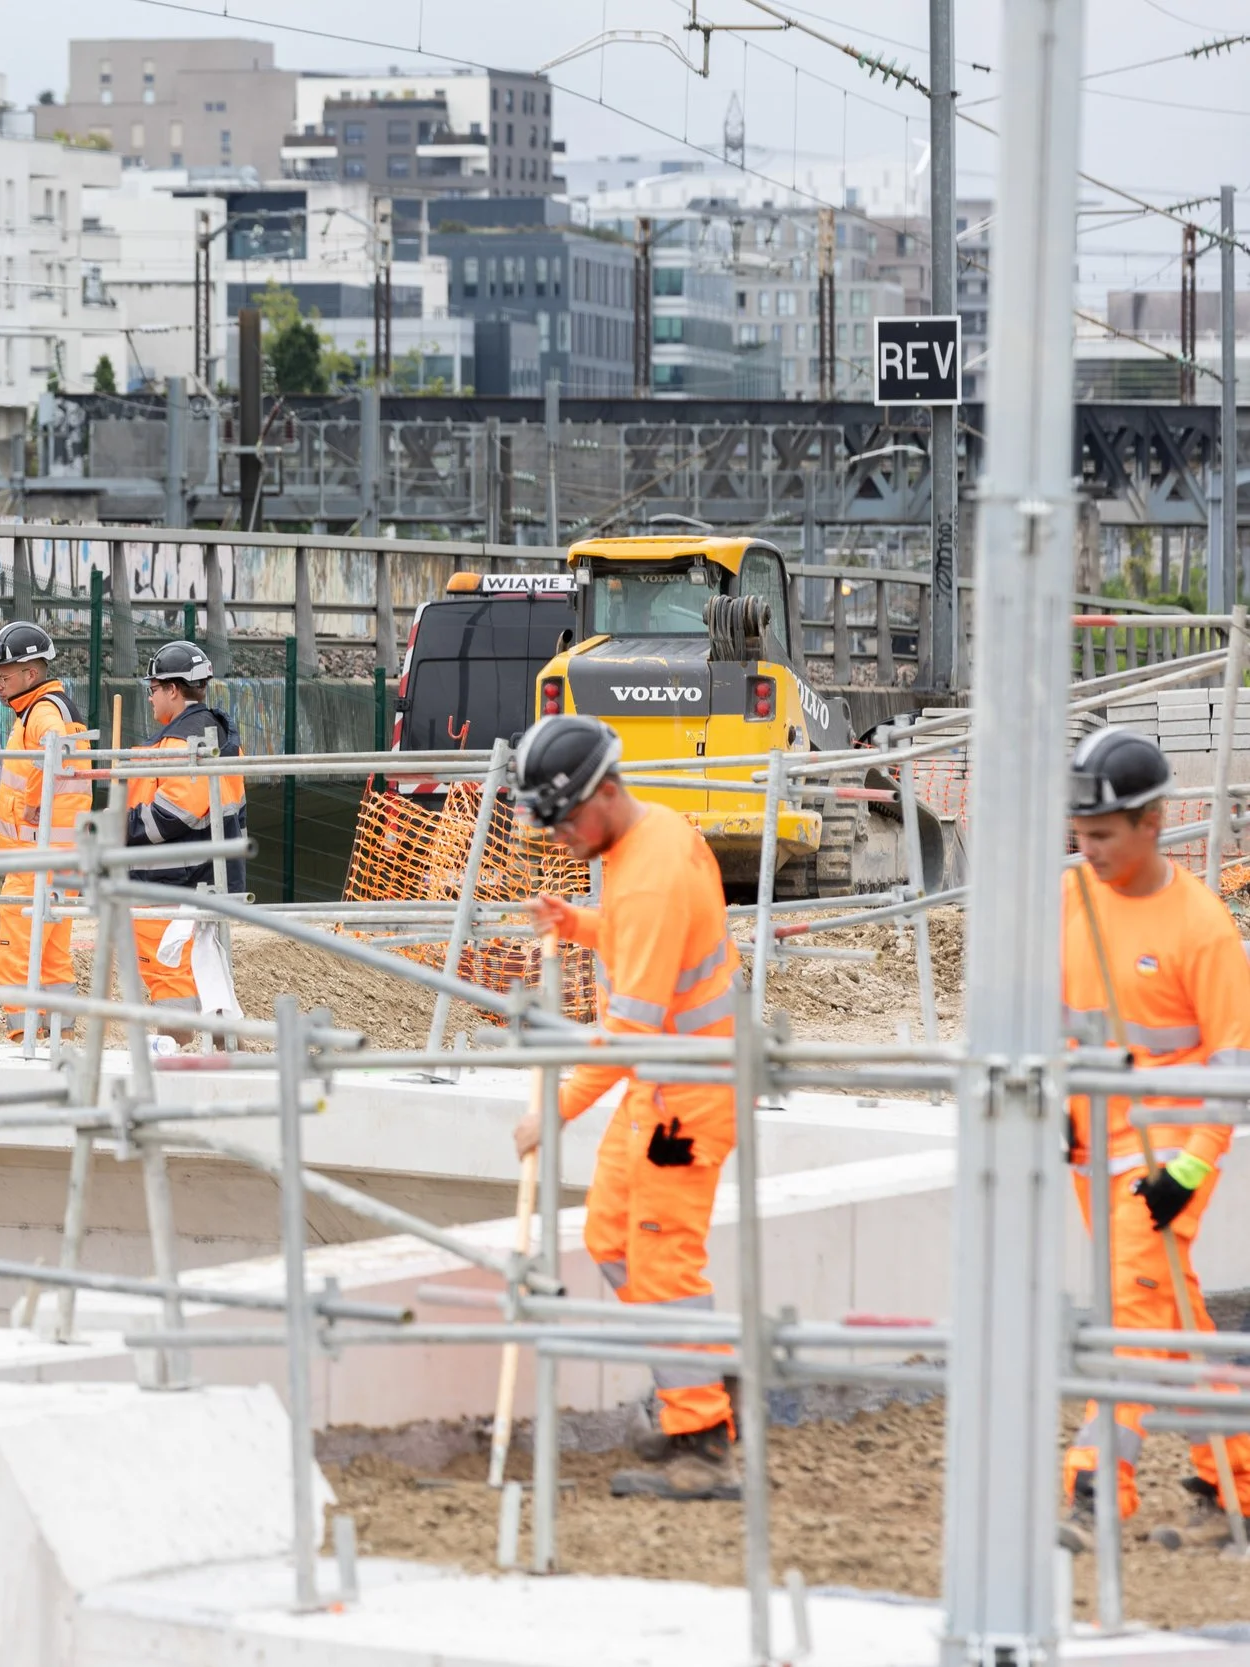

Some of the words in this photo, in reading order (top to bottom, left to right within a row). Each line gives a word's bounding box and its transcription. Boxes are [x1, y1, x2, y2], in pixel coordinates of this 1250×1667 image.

[880, 341, 955, 380] REV
[487, 577, 560, 589] WIAME
[637, 574, 686, 583] VOLVO
[610, 686, 703, 702] VOLVO
[786, 666, 830, 730] OLVO
